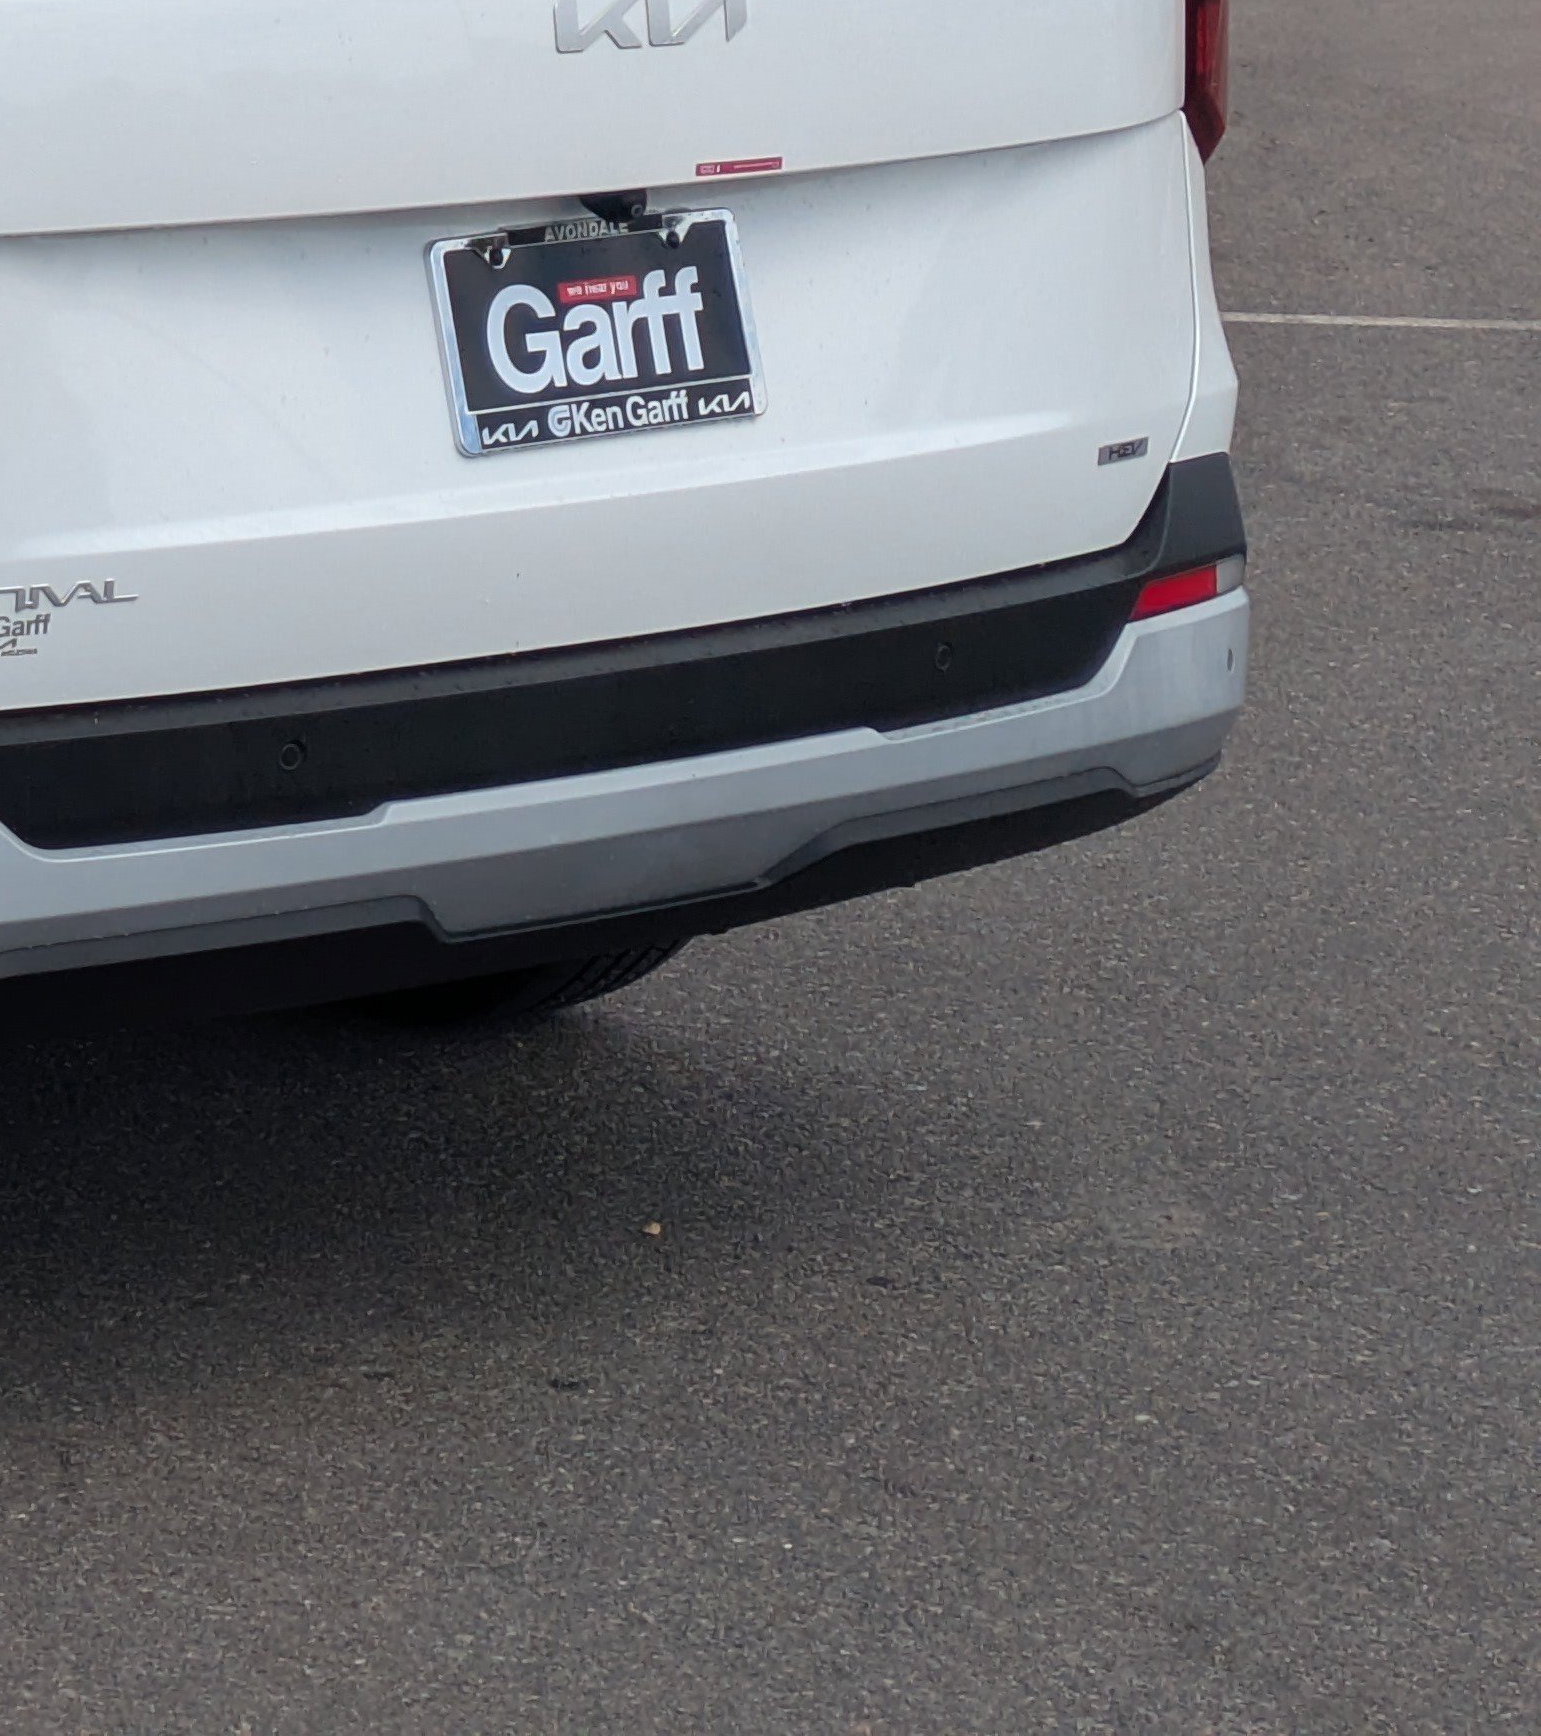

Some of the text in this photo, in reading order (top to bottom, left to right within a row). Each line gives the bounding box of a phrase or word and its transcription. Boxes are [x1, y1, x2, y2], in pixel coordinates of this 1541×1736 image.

[544, 219, 629, 243] AVONDALE
[486, 265, 705, 394] Garff
[482, 419, 539, 445] KIA
[572, 401, 625, 434] Ken
[625, 389, 689, 427] Garff
[698, 390, 751, 416] KIA
